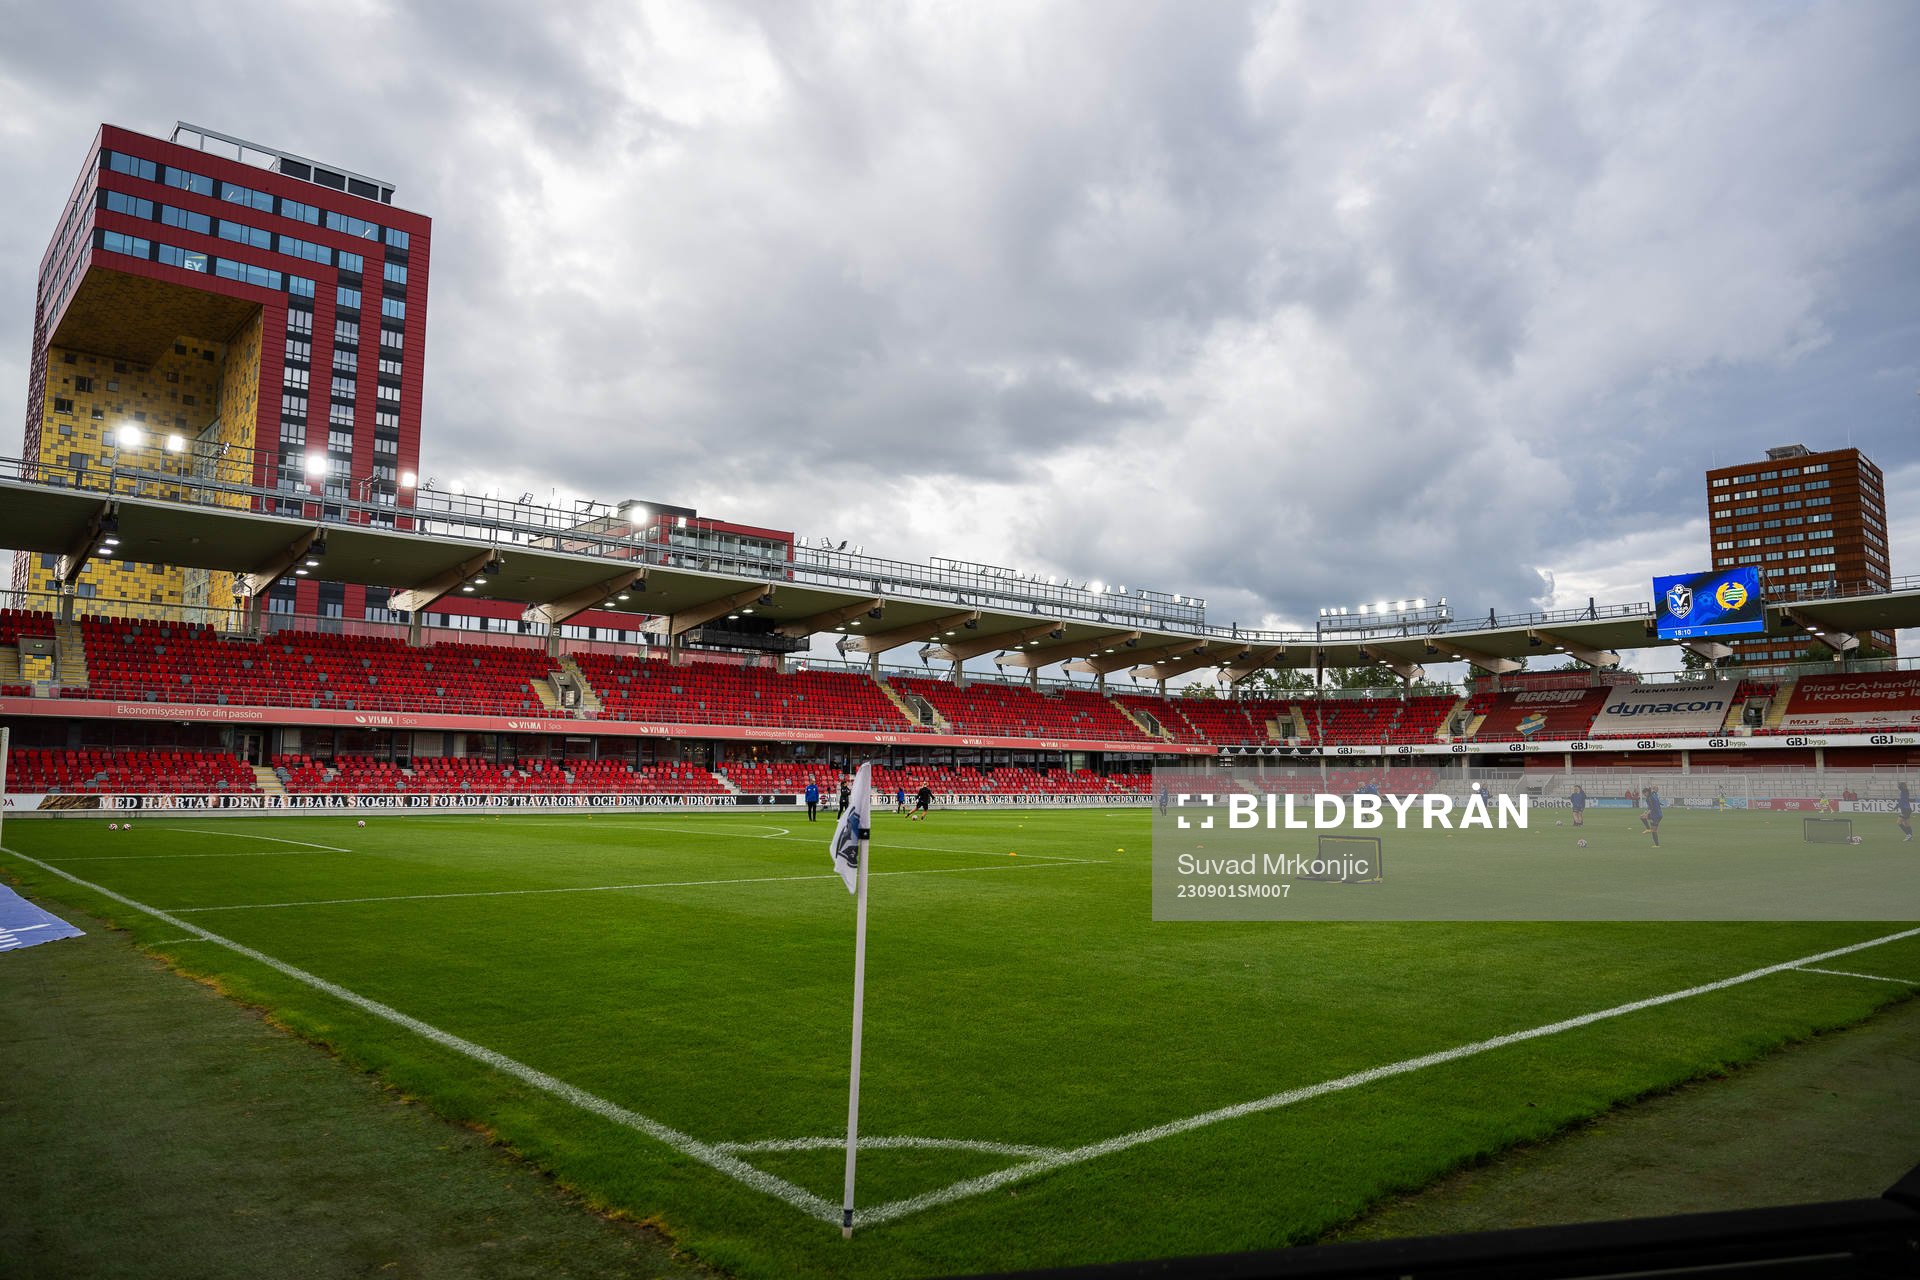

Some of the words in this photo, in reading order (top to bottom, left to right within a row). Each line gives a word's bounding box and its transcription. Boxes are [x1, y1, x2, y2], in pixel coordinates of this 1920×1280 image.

[184, 260, 202, 271] EY
[1814, 690, 1905, 700] Kronobergs
[117, 705, 194, 717] Ekonomisystem
[196, 708, 209, 717] för
[212, 708, 227, 718] din
[228, 709, 263, 720] passion
[1606, 701, 1723, 716] dynacon
[368, 715, 393, 725] VISMA
[519, 721, 541, 730] VISMA
[1637, 740, 1655, 749] GBJ
[1709, 739, 1729, 748] GBJ
[1786, 737, 1808, 746] GBJ
[1870, 735, 1894, 745] GBJ
[1571, 742, 1588, 750] GBJ
[99, 796, 137, 809] MED
[219, 796, 225, 808] I
[229, 796, 261, 808] DEN
[411, 796, 429, 807] DE
[432, 794, 508, 807] FÖRÄDLADE
[593, 796, 616, 806] OCH
[618, 796, 640, 806] DEN
[643, 796, 684, 806] LOKALA
[686, 796, 737, 806] IDROTTEN
